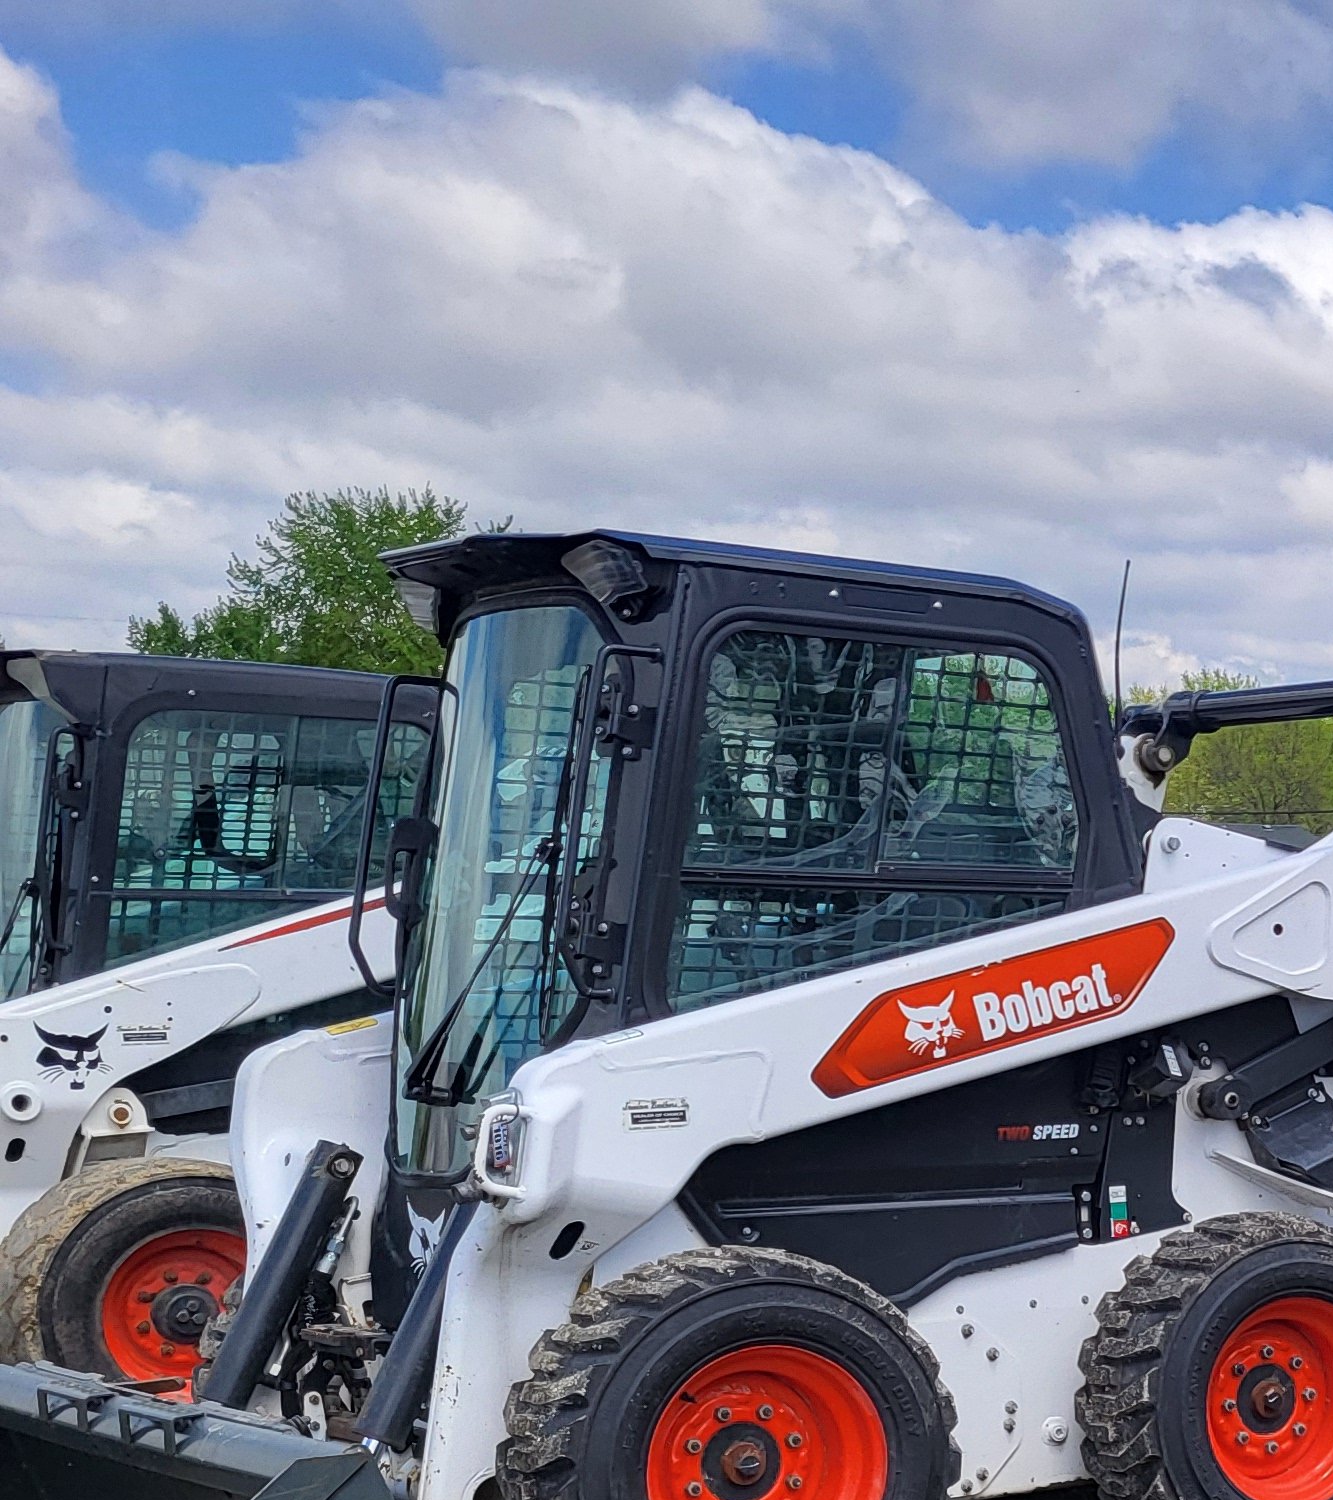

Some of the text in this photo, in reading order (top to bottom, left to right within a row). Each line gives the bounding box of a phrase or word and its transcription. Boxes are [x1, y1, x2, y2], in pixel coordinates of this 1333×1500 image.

[972, 963, 1114, 1042] Bobcat
[997, 1123, 1079, 1141] TWO SPEED
